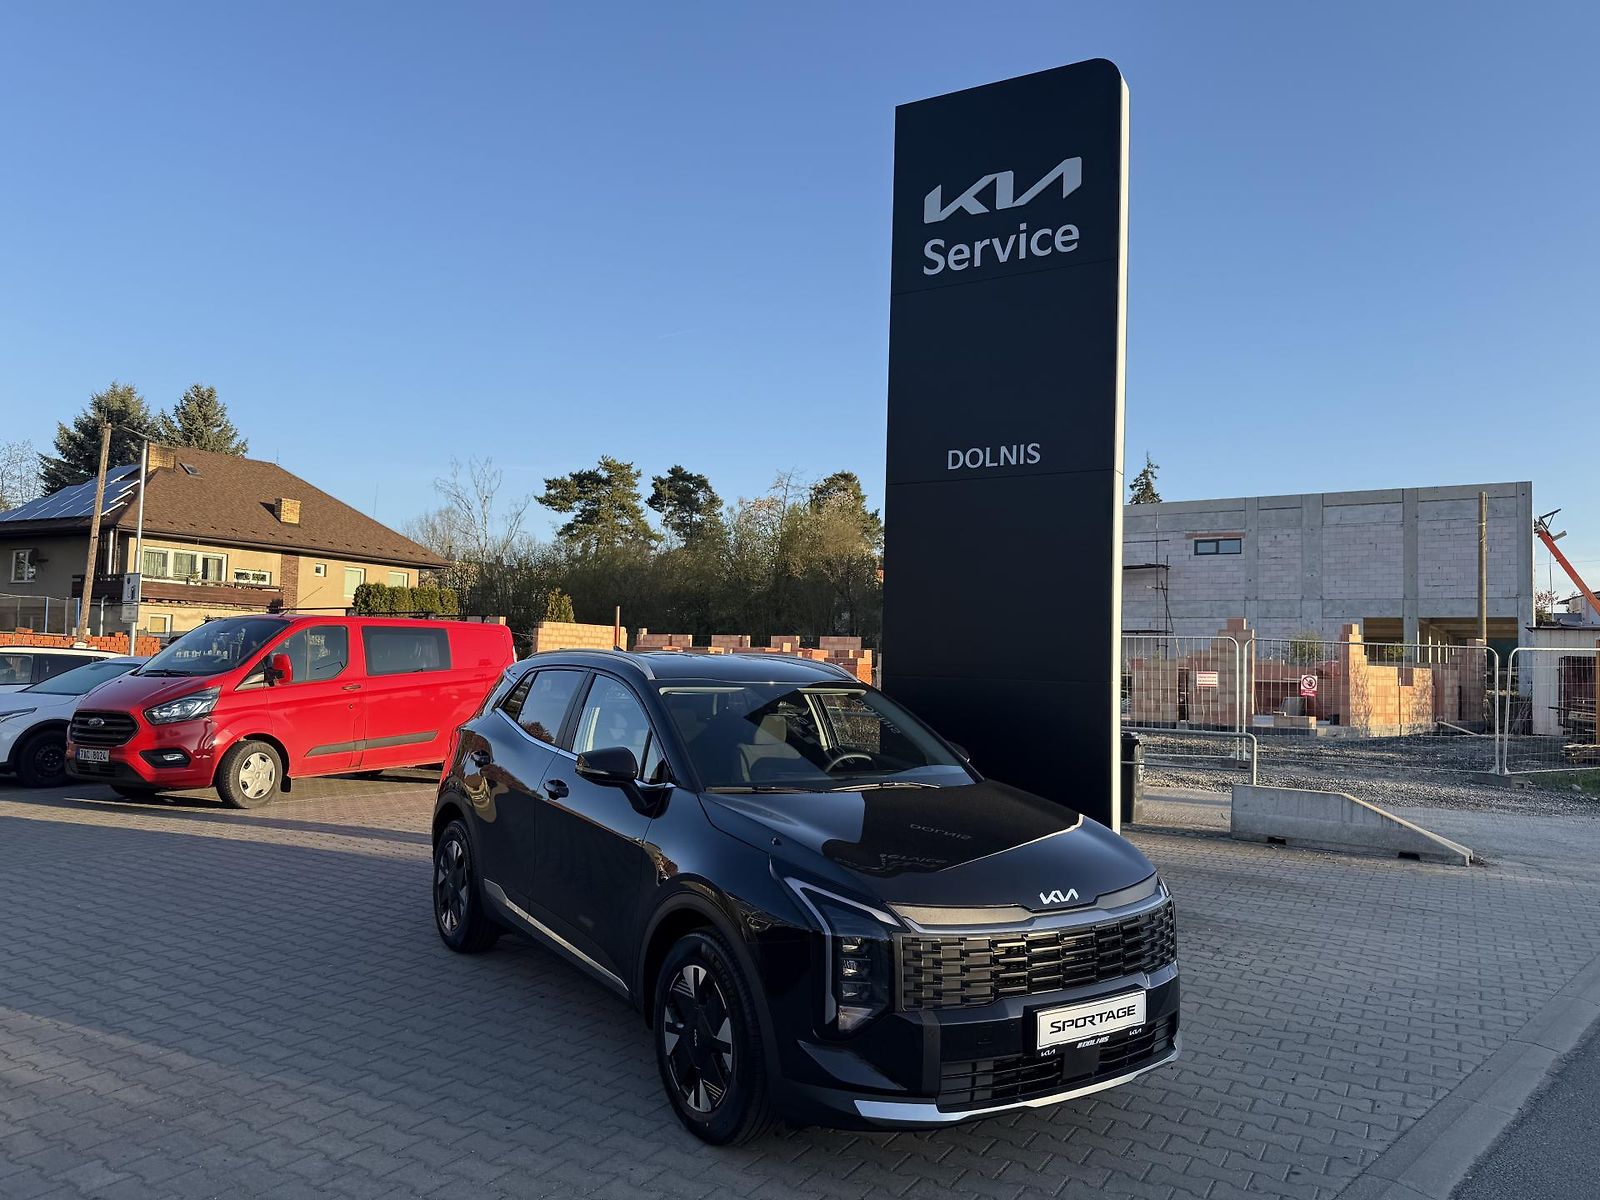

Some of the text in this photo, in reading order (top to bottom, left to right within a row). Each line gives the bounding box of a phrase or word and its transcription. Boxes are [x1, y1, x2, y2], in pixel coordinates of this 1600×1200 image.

[923, 156, 1083, 225] KIA
[922, 222, 1080, 276] Service
[946, 442, 1042, 471] DOLNIS
[1039, 888, 1079, 905] KIA
[1049, 1004, 1137, 1035] SPORTAGE
